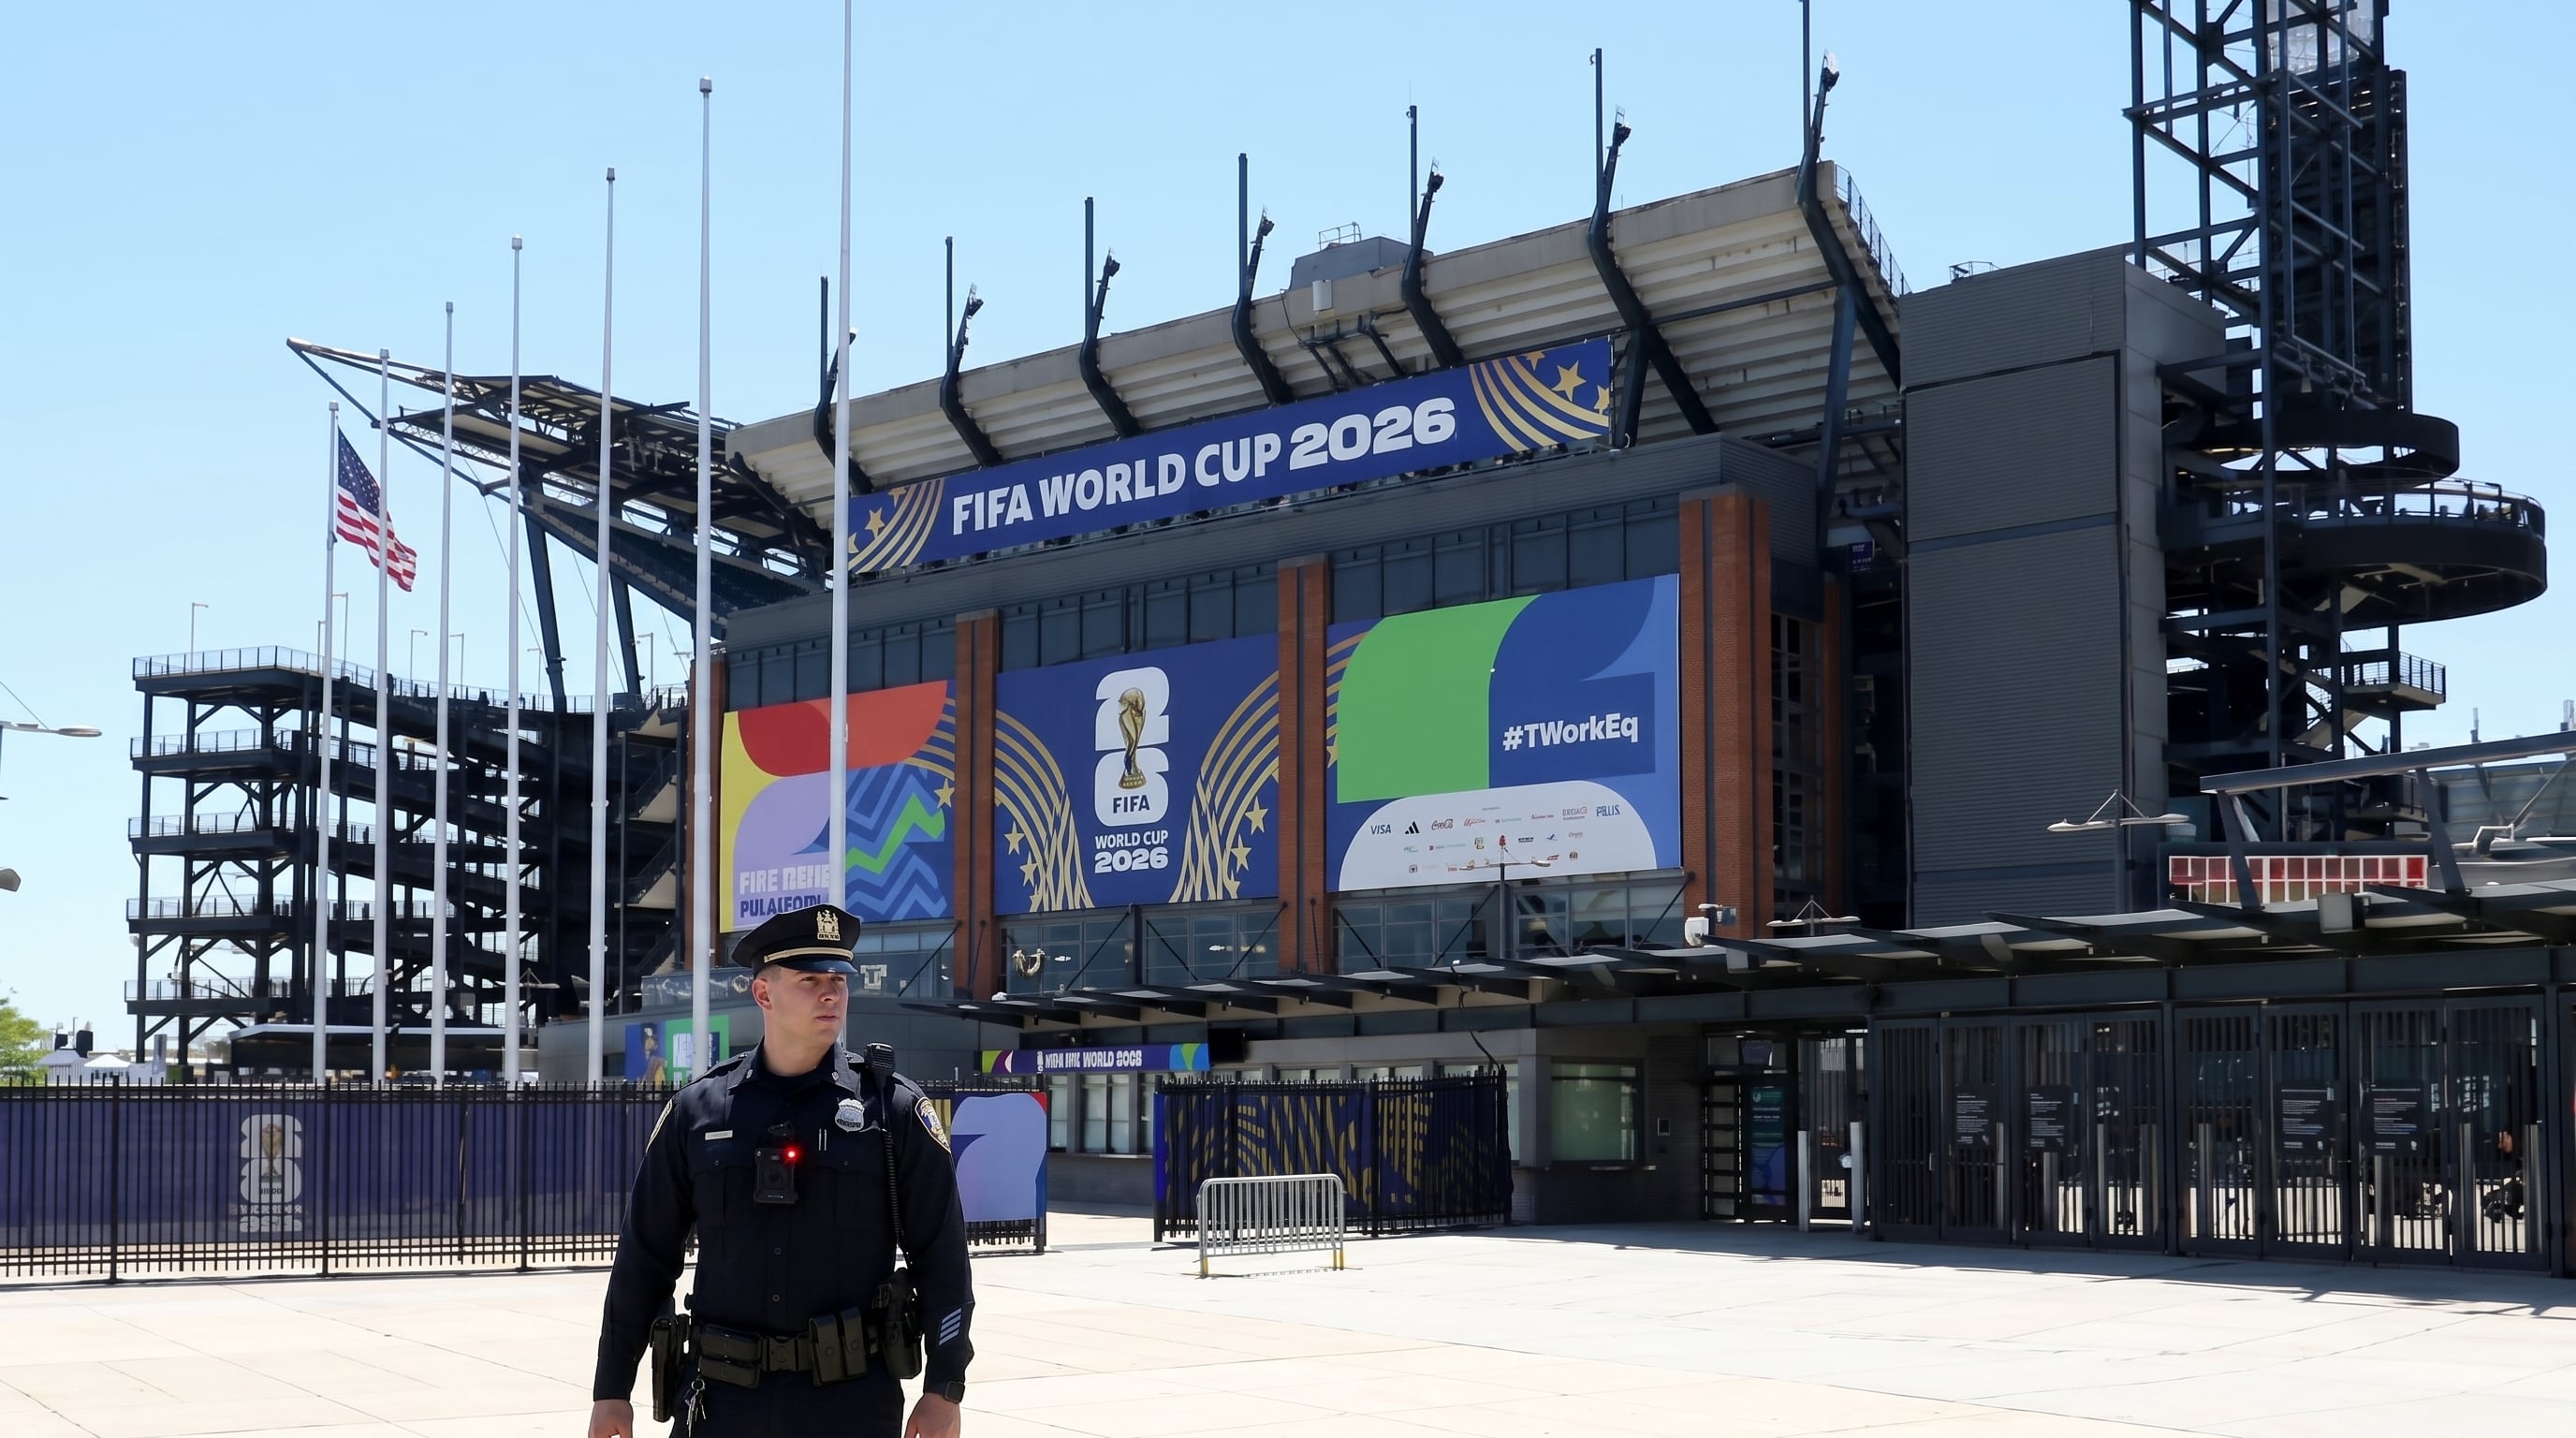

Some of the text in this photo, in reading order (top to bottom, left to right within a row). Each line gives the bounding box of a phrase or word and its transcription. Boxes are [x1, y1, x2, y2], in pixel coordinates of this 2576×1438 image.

[953, 397, 1456, 536] FIFA WORLD CUP 2026
[1502, 712, 1638, 751] #TWorkEq
[1112, 795, 1150, 814] FIFA
[1095, 829, 1169, 849] WORLD CUP
[1370, 824, 1392, 835] VISA
[1094, 846, 1169, 873] 2026
[739, 868, 779, 895] FIRE
[1083, 1050, 1115, 1068] WORLD
